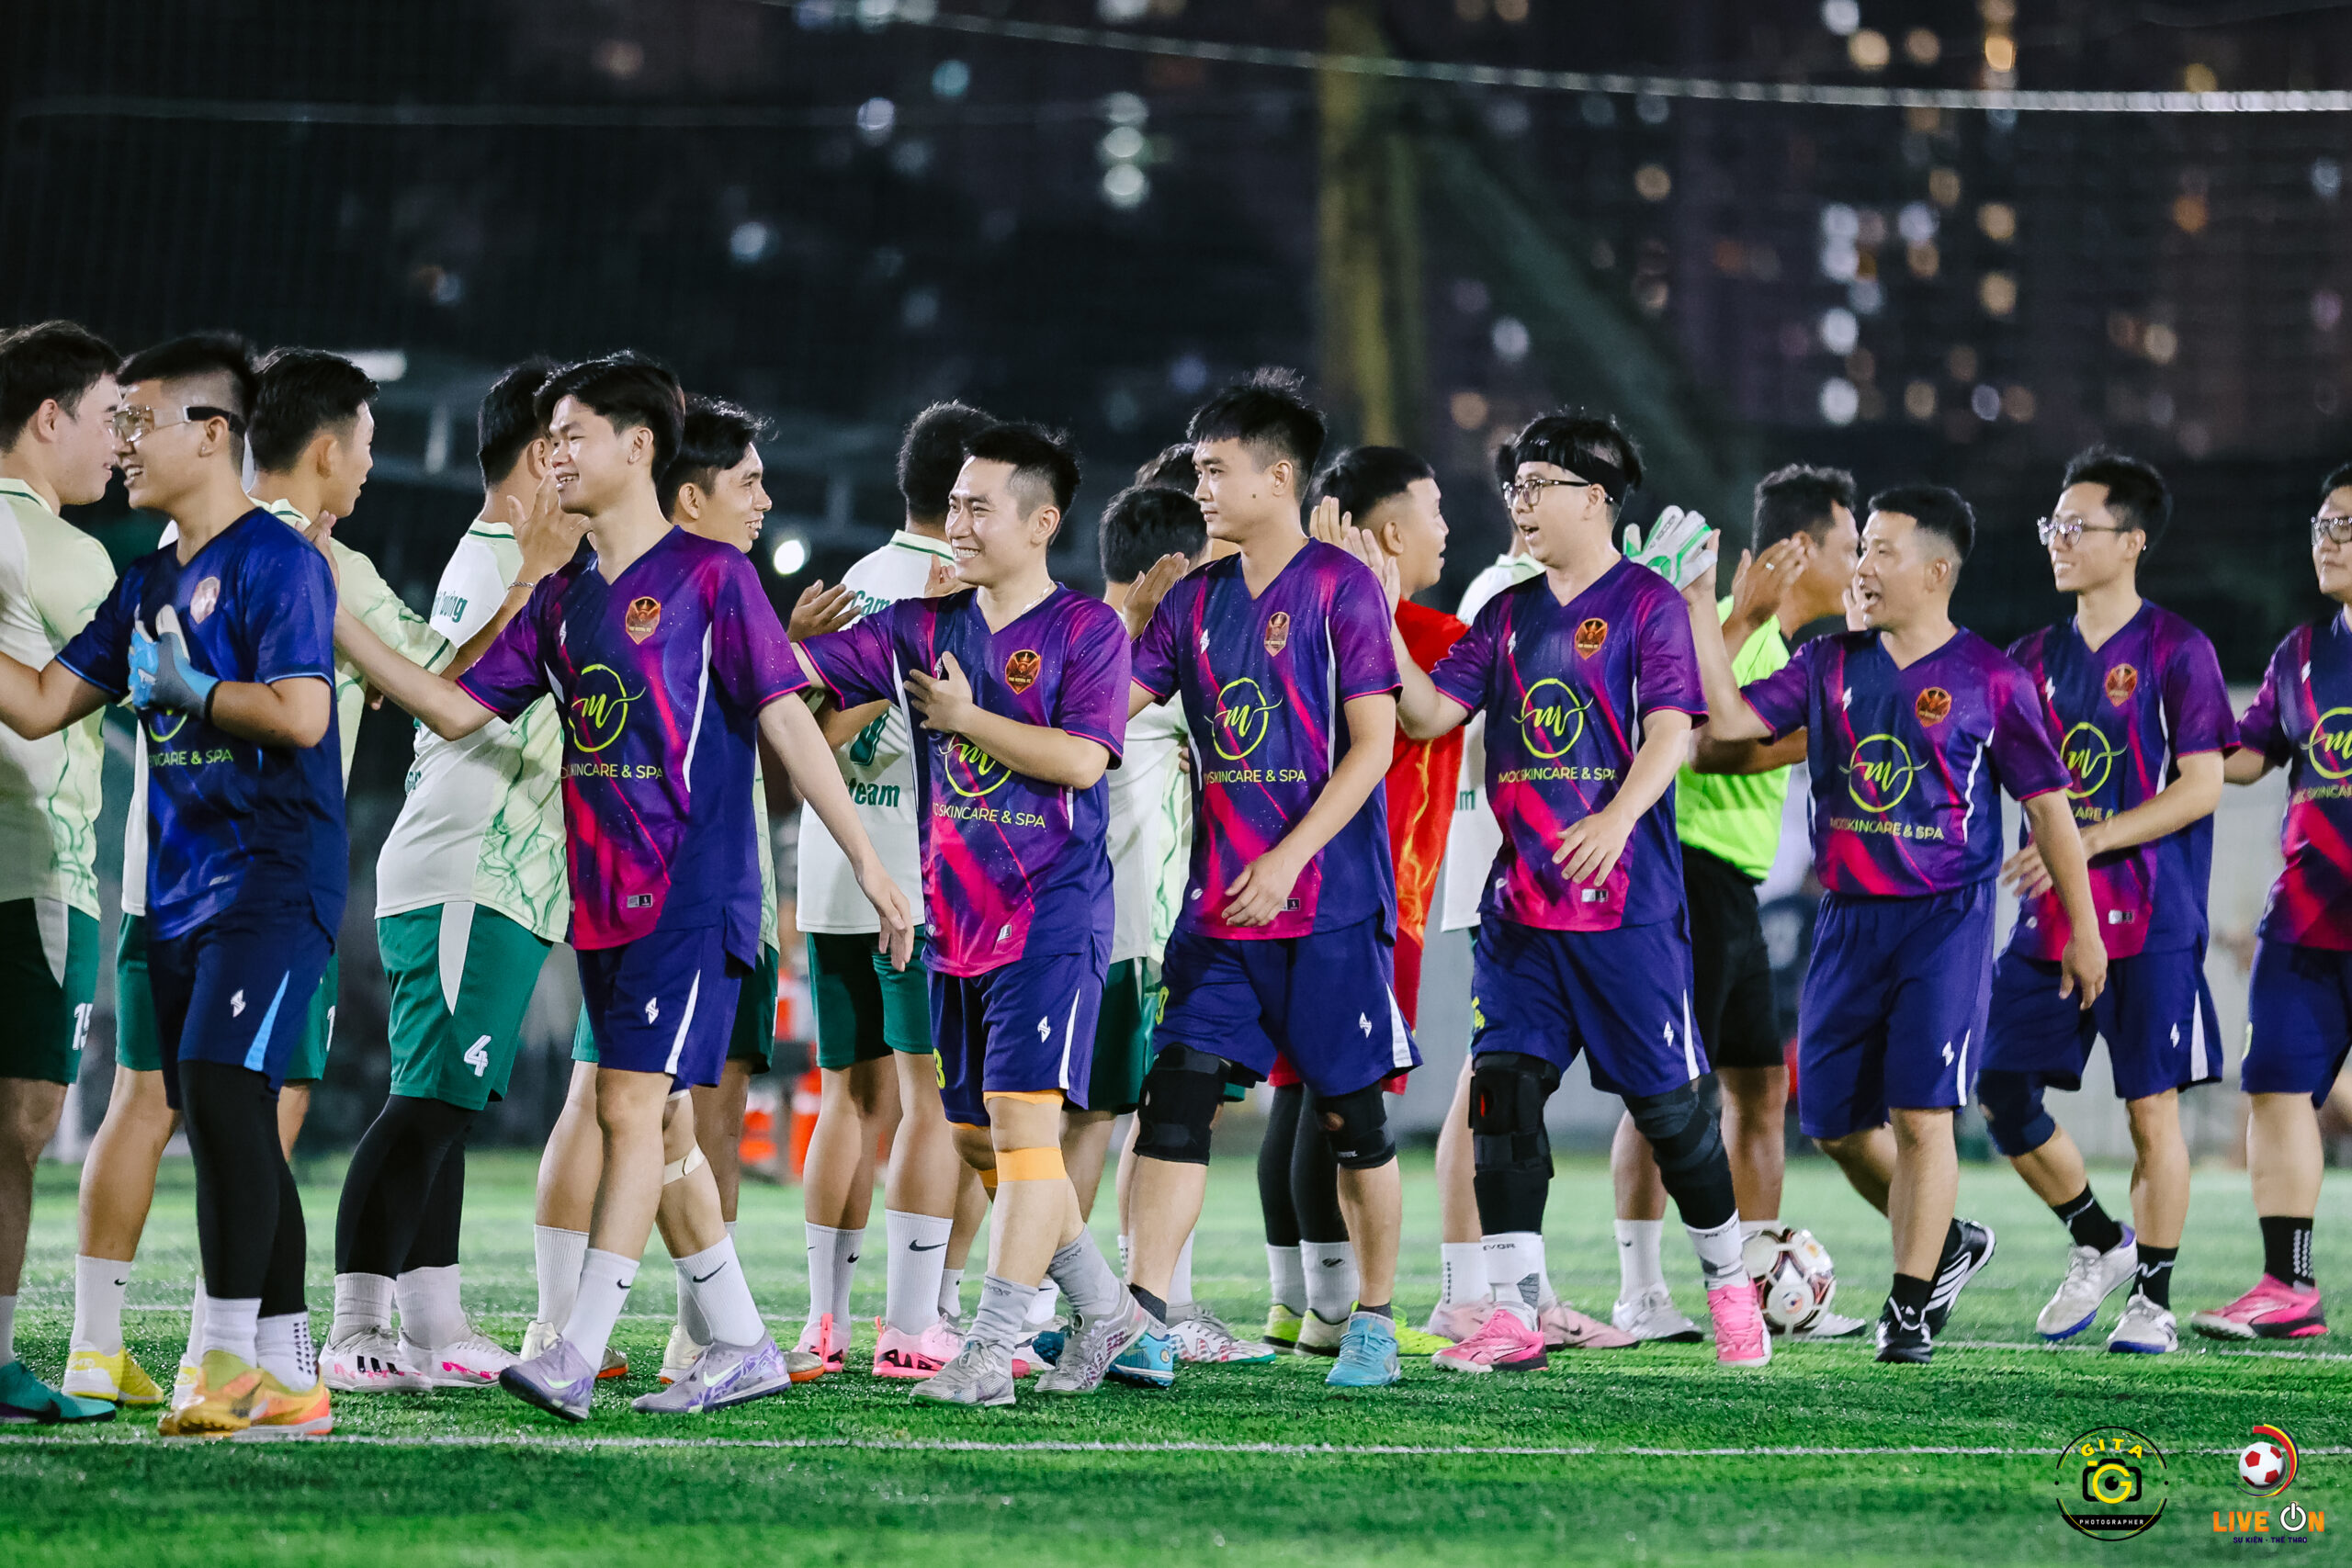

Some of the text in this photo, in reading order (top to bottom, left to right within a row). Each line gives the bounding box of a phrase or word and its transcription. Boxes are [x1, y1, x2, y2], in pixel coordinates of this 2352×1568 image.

[190, 750, 202, 765] &
[205, 749, 233, 764] SPA
[621, 764, 632, 778] &
[635, 764, 662, 779] SPA
[1265, 769, 1277, 783] &
[1279, 769, 1307, 783] SPA
[1580, 767, 1591, 781] &
[938, 804, 999, 823] SKINCARE
[1001, 809, 1012, 825] &
[1014, 812, 1046, 829] SPA
[463, 1034, 492, 1077] 4
